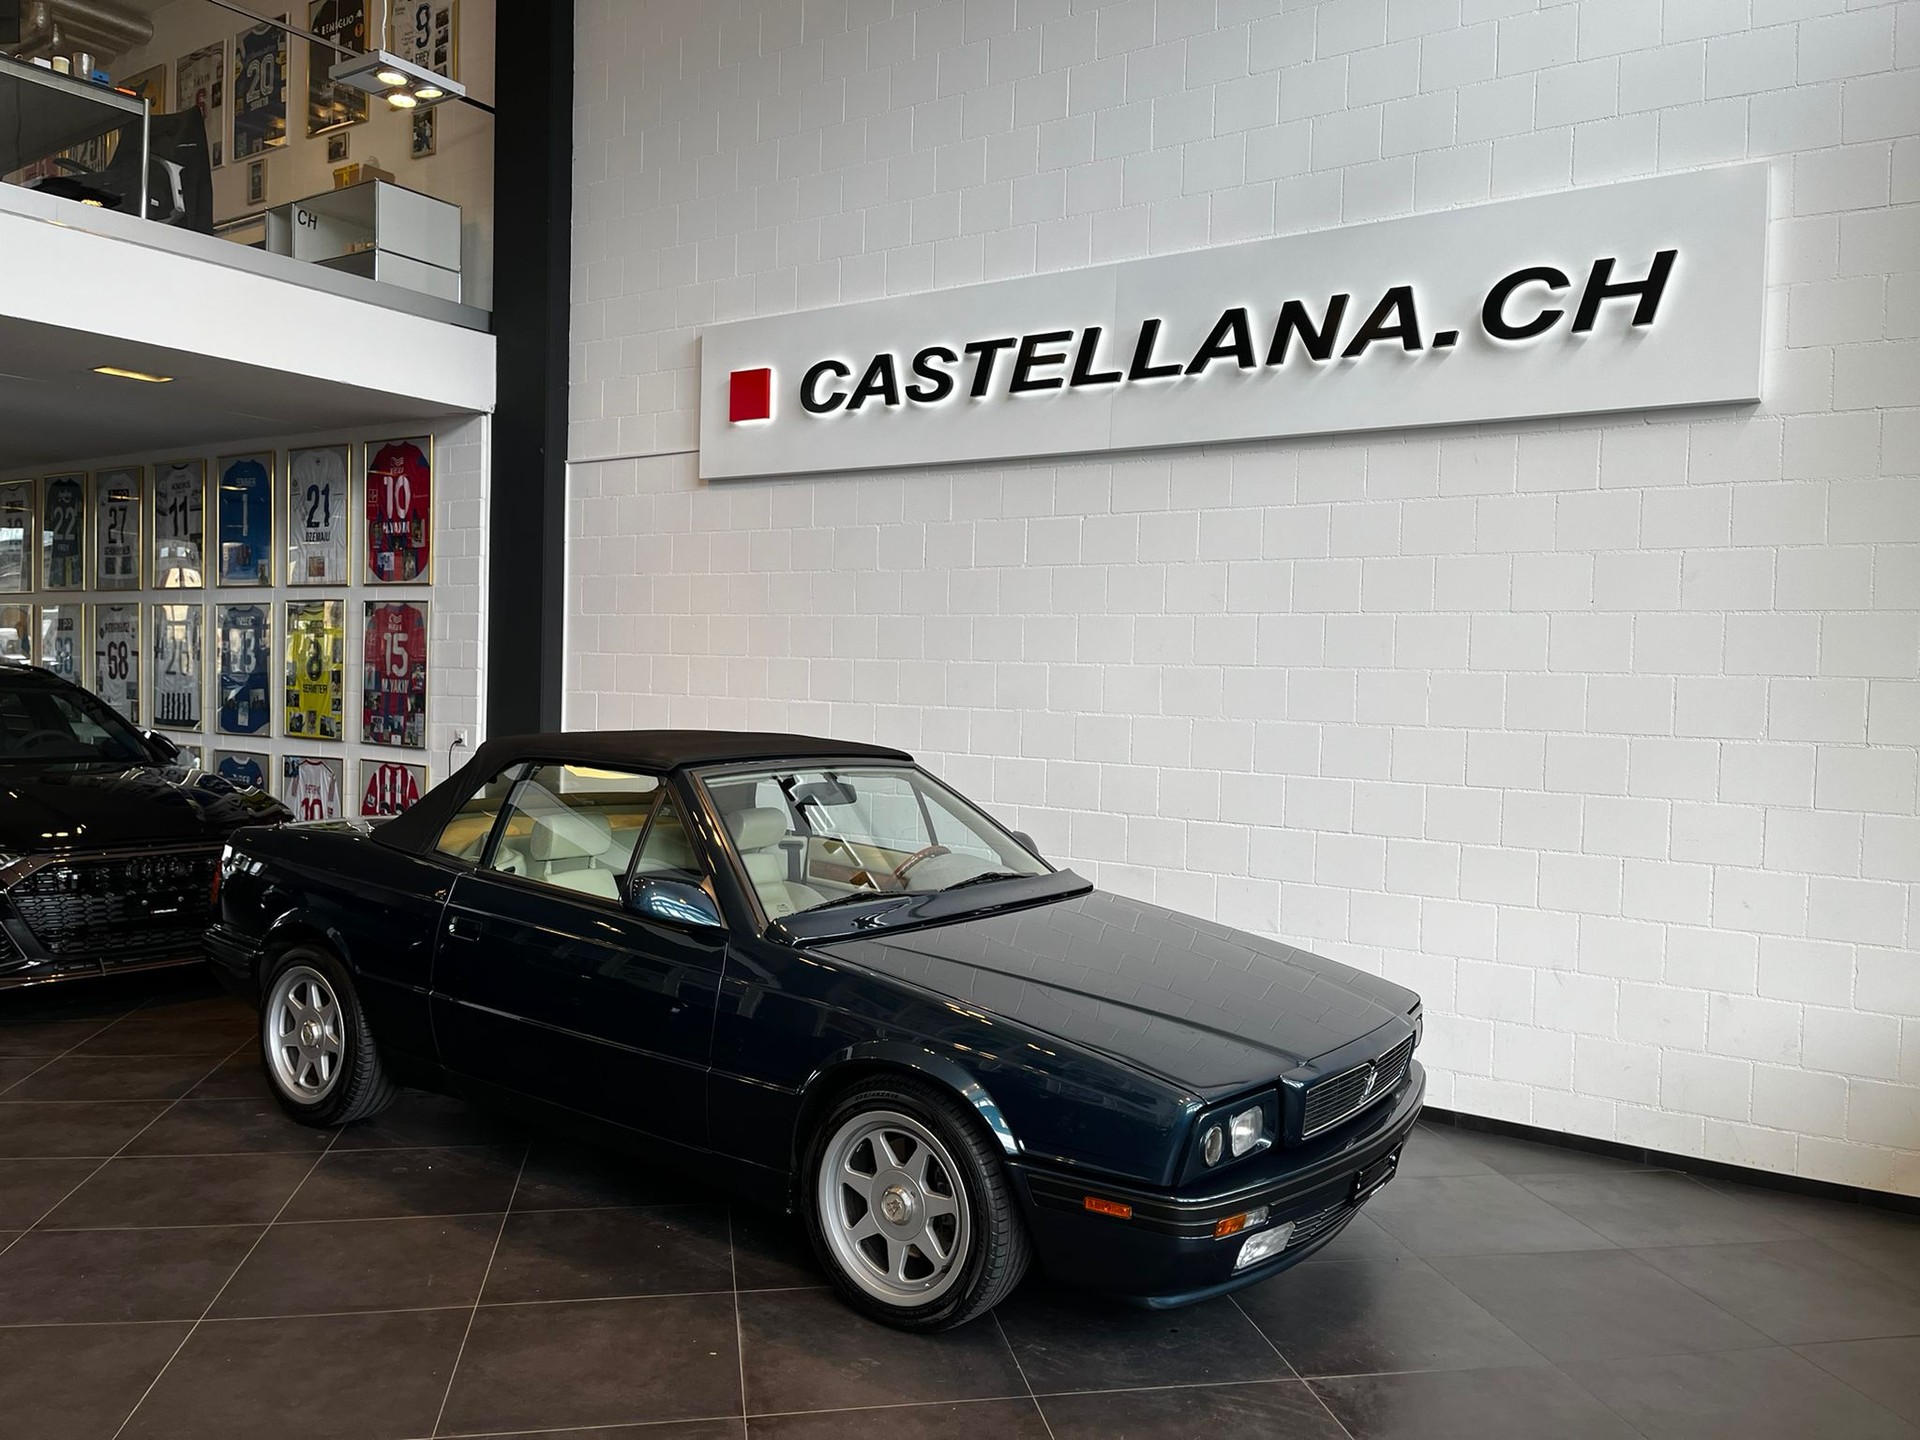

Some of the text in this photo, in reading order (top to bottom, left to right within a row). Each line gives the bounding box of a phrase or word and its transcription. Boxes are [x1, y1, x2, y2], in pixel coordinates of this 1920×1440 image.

[416, 3, 431, 48] 9
[246, 53, 275, 104] 20
[297, 209, 318, 230] CH
[799, 249, 1678, 414] CASTELLANA.CH
[169, 496, 189, 537] 11
[306, 483, 331, 528] 21
[384, 475, 411, 519] 10
[53, 506, 76, 541] 22
[108, 505, 128, 544] 27
[107, 641, 129, 680] 68
[383, 632, 409, 678] 15
